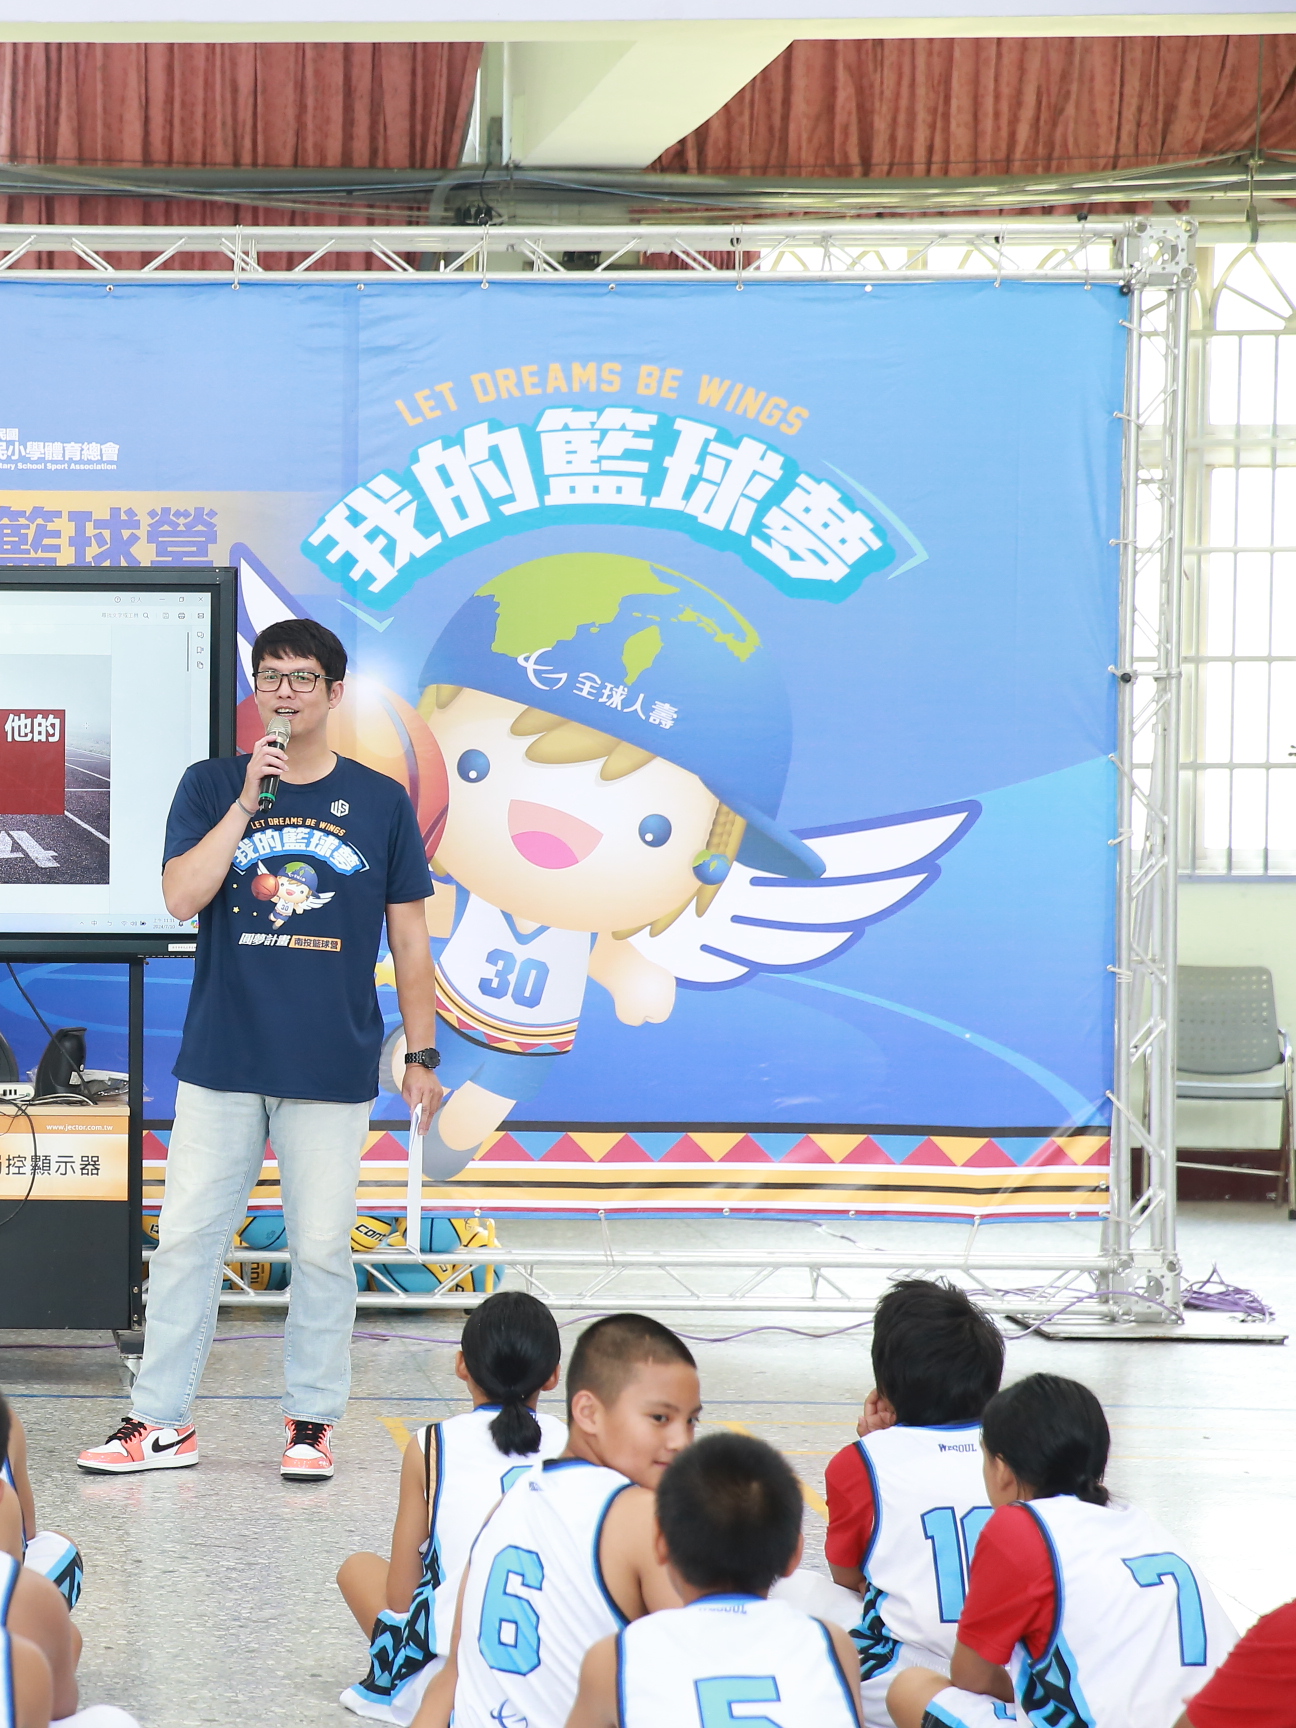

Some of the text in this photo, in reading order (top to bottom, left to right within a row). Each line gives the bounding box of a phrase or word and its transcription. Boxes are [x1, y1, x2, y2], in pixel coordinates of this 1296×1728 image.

[395, 361, 810, 437] LET DREAMS BE WINGS
[17, 462, 45, 470] School
[46, 462, 69, 471] Sport
[69, 462, 117, 470] Association
[307, 406, 884, 594] 我的籃球夢
[572, 670, 680, 730] 全球人壽
[233, 826, 361, 872] 我的籃球夢
[250, 817, 346, 837] LET DREAMS BE WINGS
[238, 932, 291, 947] 圓夢計畫
[477, 948, 550, 1010] 30
[46, 1123, 114, 1132] www.jector.com.tw
[478, 1544, 545, 1676] 6
[1120, 1551, 1208, 1668] 7
